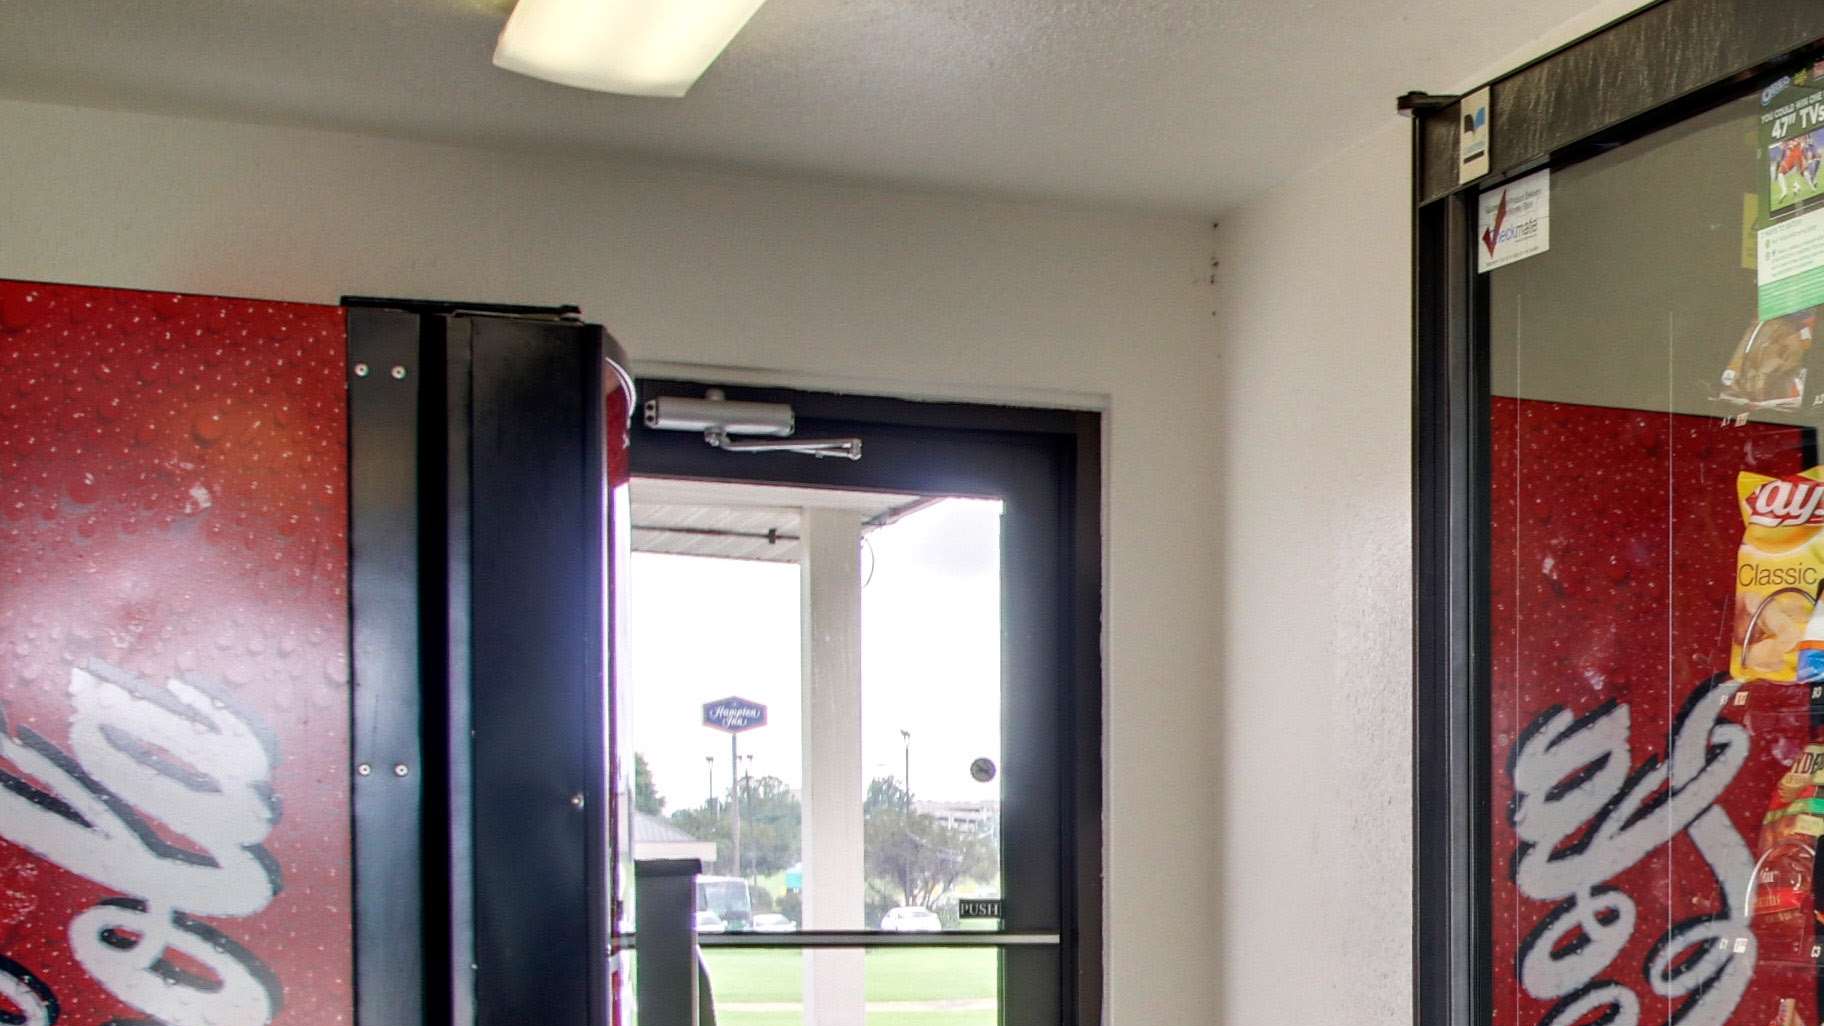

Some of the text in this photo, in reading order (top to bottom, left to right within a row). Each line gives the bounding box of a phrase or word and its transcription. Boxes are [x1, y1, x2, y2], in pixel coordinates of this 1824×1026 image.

[1771, 112, 1797, 139] 47"
[1738, 563, 1817, 587] Classic
[709, 704, 760, 719] Hampton
[960, 902, 999, 916] PUSH
